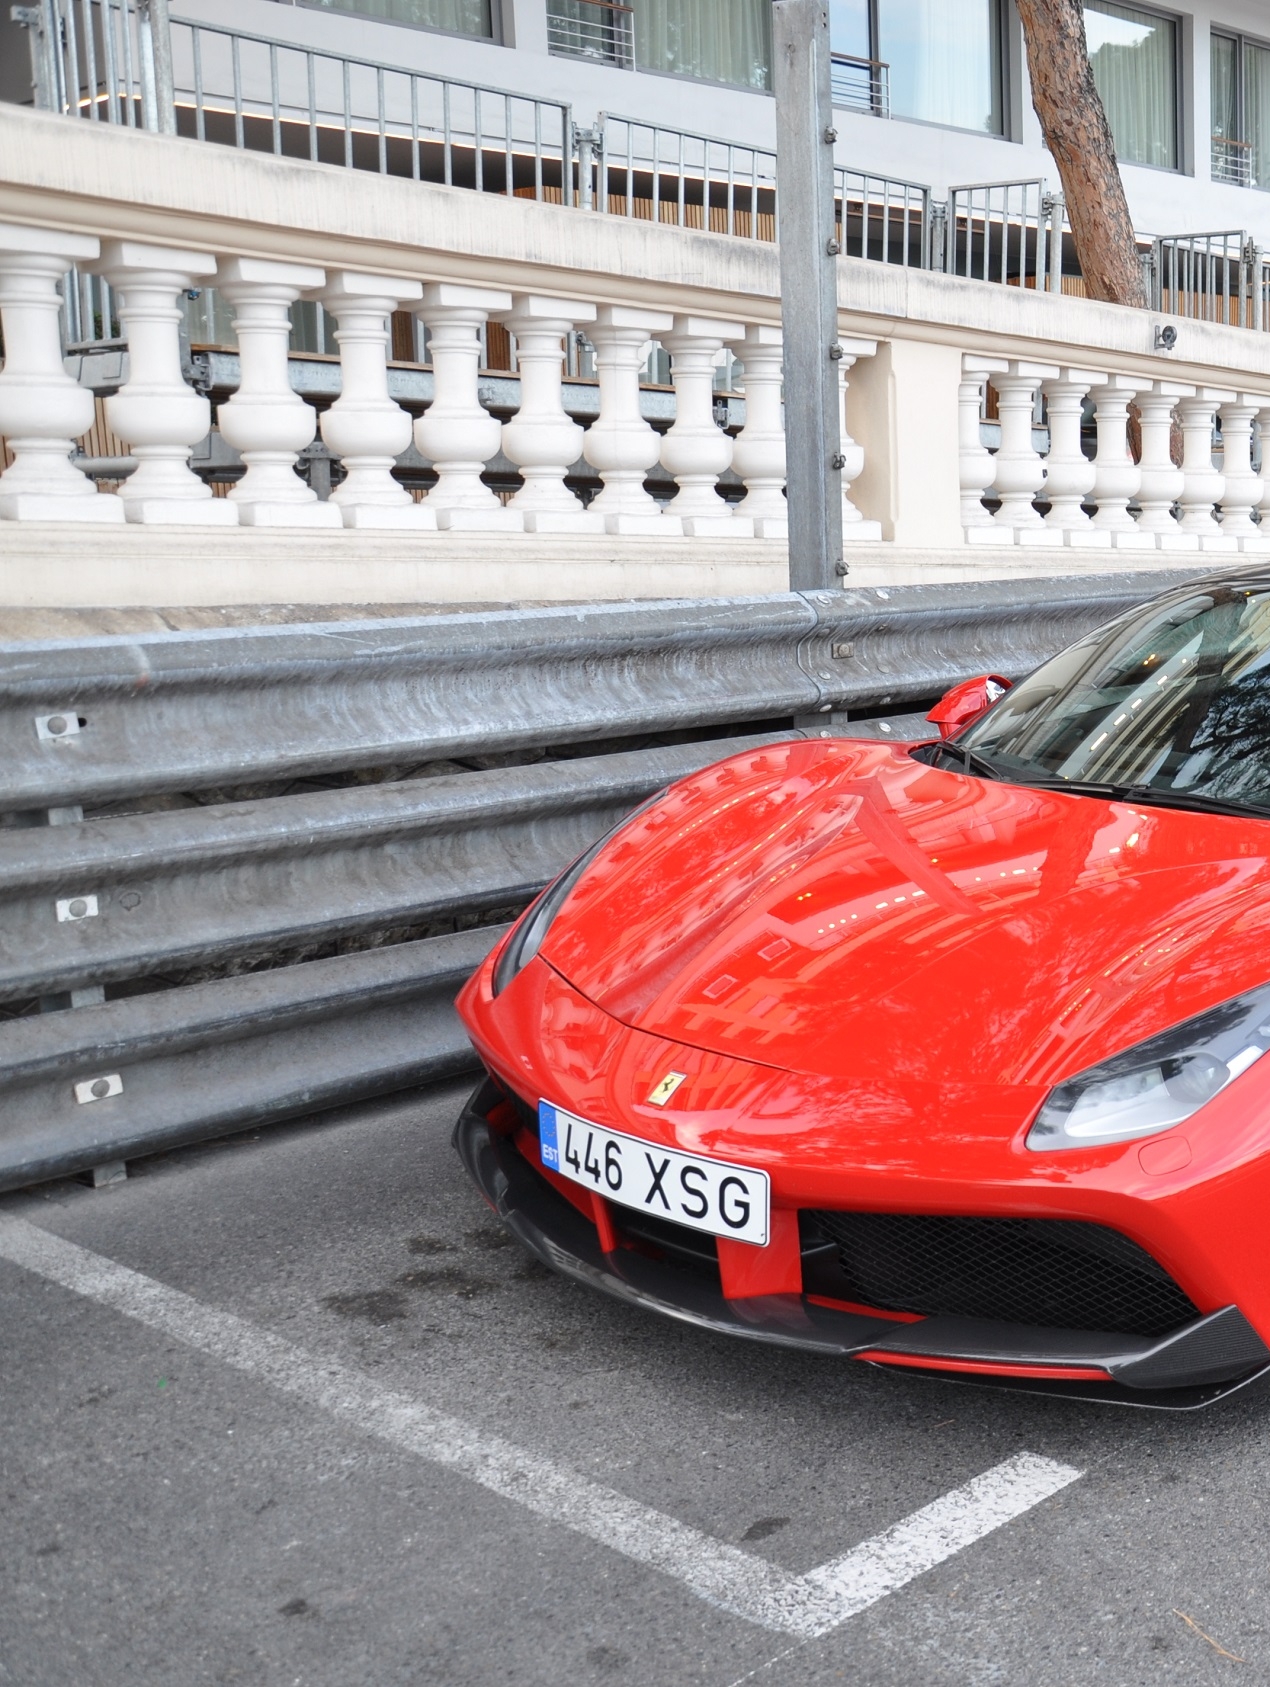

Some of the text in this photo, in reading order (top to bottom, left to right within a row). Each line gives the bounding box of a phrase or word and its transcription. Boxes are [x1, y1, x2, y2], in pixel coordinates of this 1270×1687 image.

[542, 1143, 558, 1163] EST
[564, 1122, 750, 1229] 446 XSG
